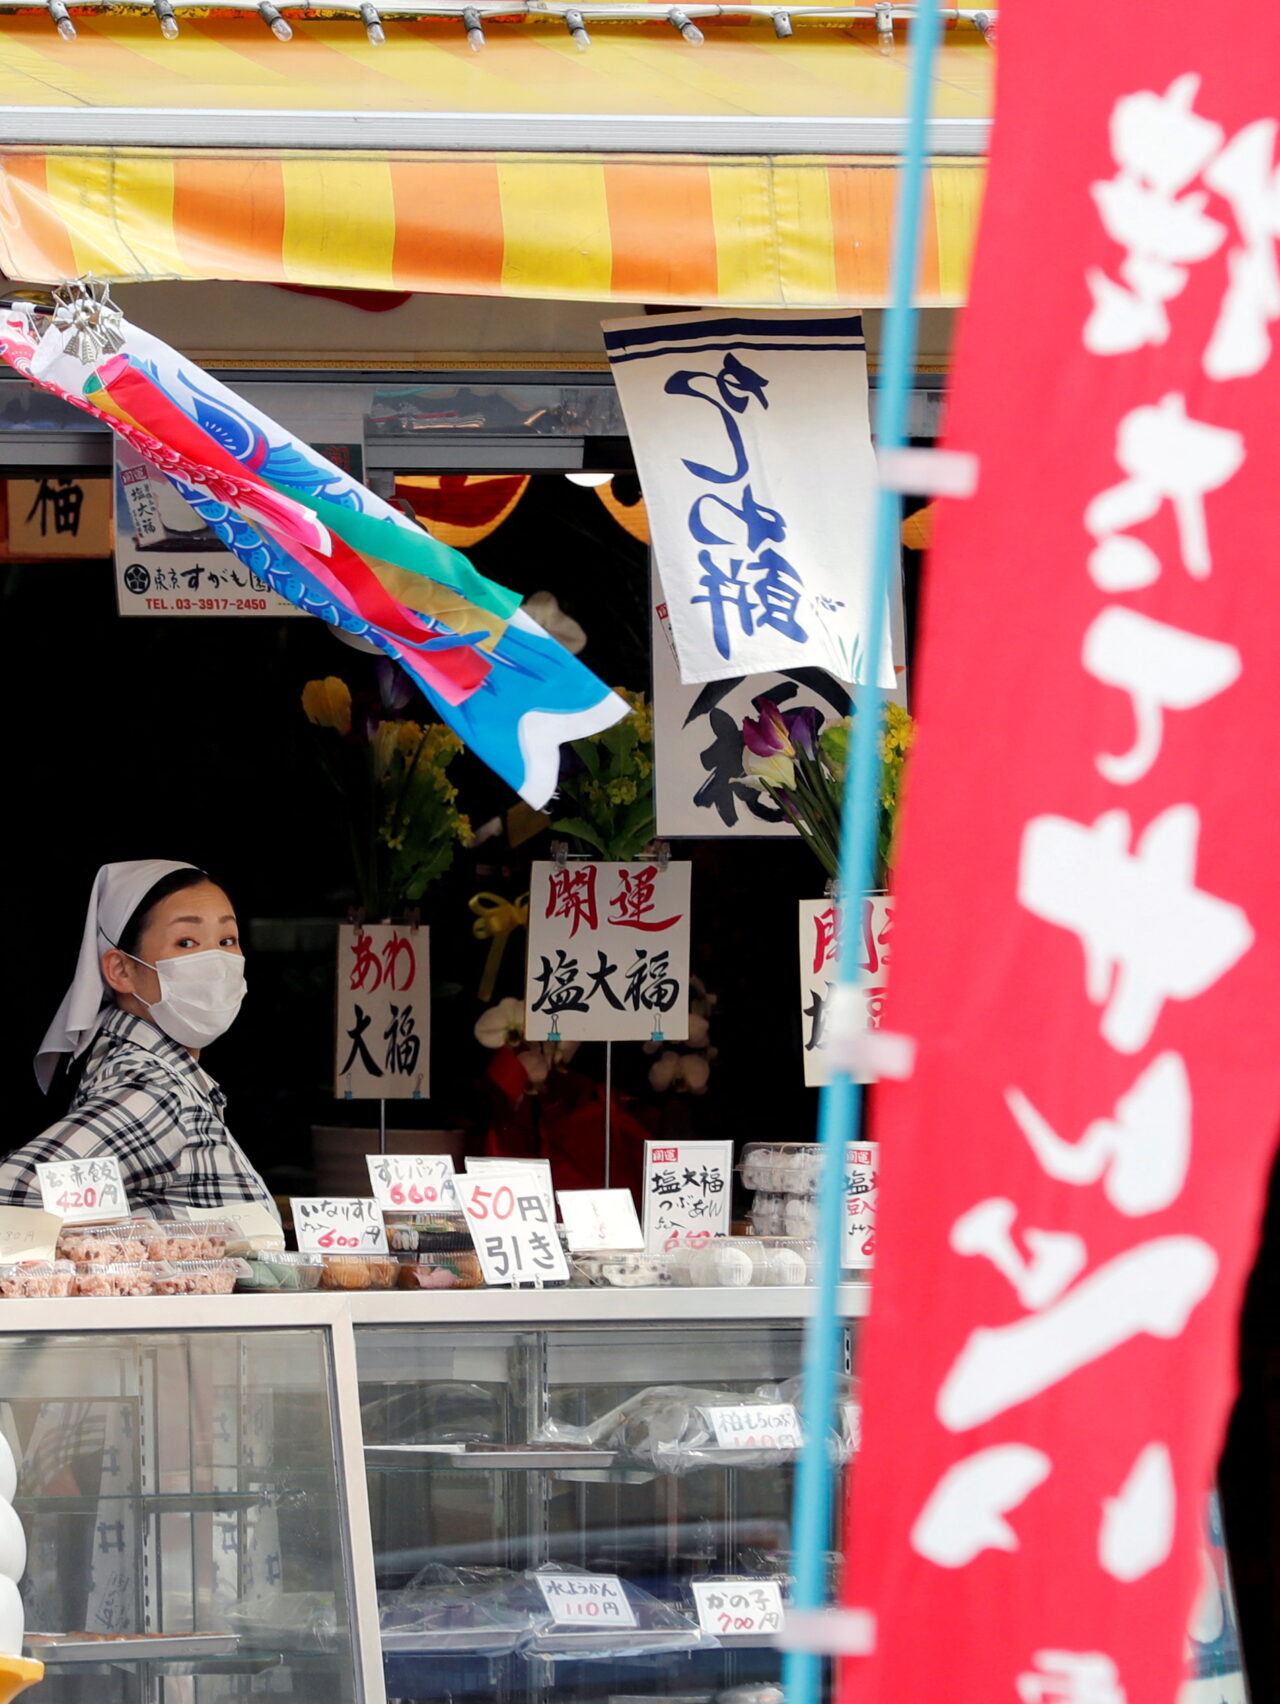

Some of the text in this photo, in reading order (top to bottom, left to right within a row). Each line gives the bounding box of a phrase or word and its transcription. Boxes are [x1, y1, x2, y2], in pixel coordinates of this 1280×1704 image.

[145, 598, 267, 610] TEL.03-3917-2450
[545, 865, 684, 939] 開運
[349, 929, 416, 994] あわ
[531, 949, 680, 1014] 塩大福
[339, 1003, 420, 1078] 大福
[390, 1179, 456, 1205] 660円
[651, 1165, 725, 1198] 塩大福
[55, 1183, 118, 1213] 420円
[467, 1185, 549, 1223] 50円
[317, 1225, 381, 1248] 600円
[485, 1231, 555, 1277] 引き
[547, 1580, 618, 1596] 水ようかん
[566, 1601, 620, 1616] 110円
[717, 1611, 780, 1633] 700円
